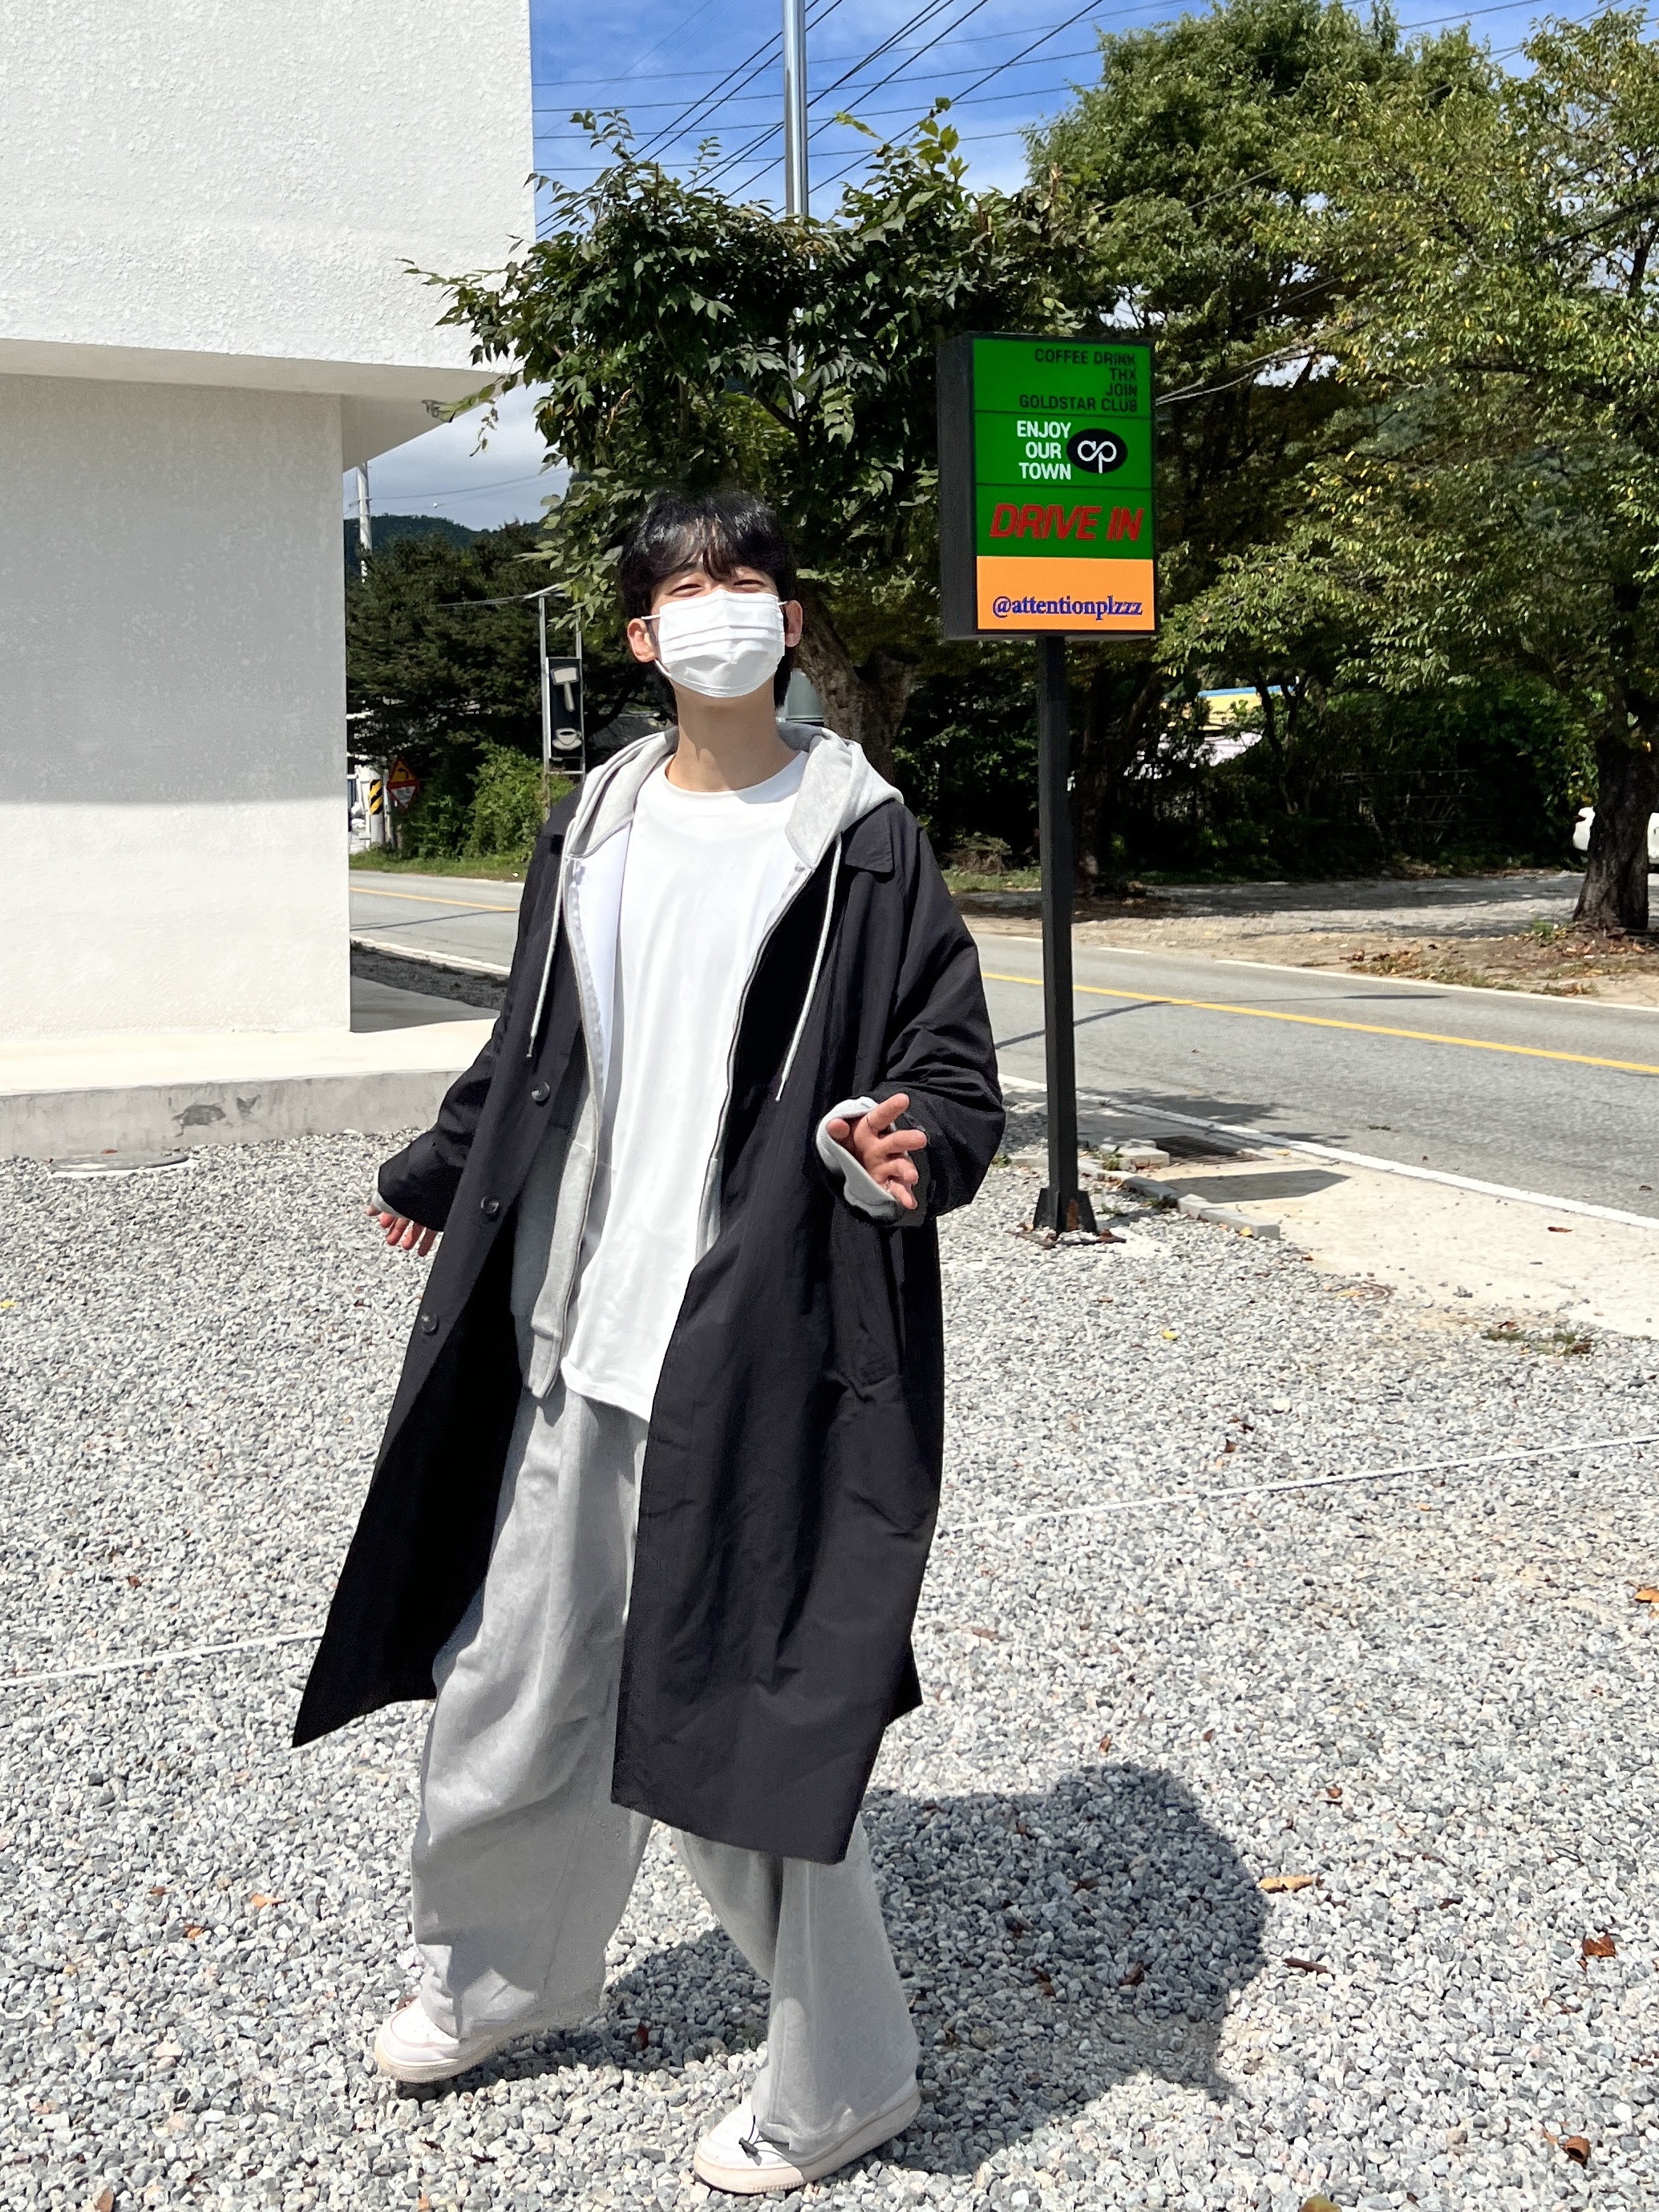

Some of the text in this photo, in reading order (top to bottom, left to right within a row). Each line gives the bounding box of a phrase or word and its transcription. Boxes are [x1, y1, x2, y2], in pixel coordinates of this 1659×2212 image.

[1034, 349, 1088, 365] COFFEE
[1110, 367, 1136, 381] THX
[1106, 383, 1138, 397] JOIN
[1019, 394, 1138, 412] GOLDSTAR CLUB
[1017, 420, 1071, 439] ENJOY
[1026, 442, 1062, 459] OUR
[1018, 463, 1071, 480] TOWN
[989, 503, 1144, 540] DRIVE IN
[993, 595, 1143, 621] @attentionplzzz
